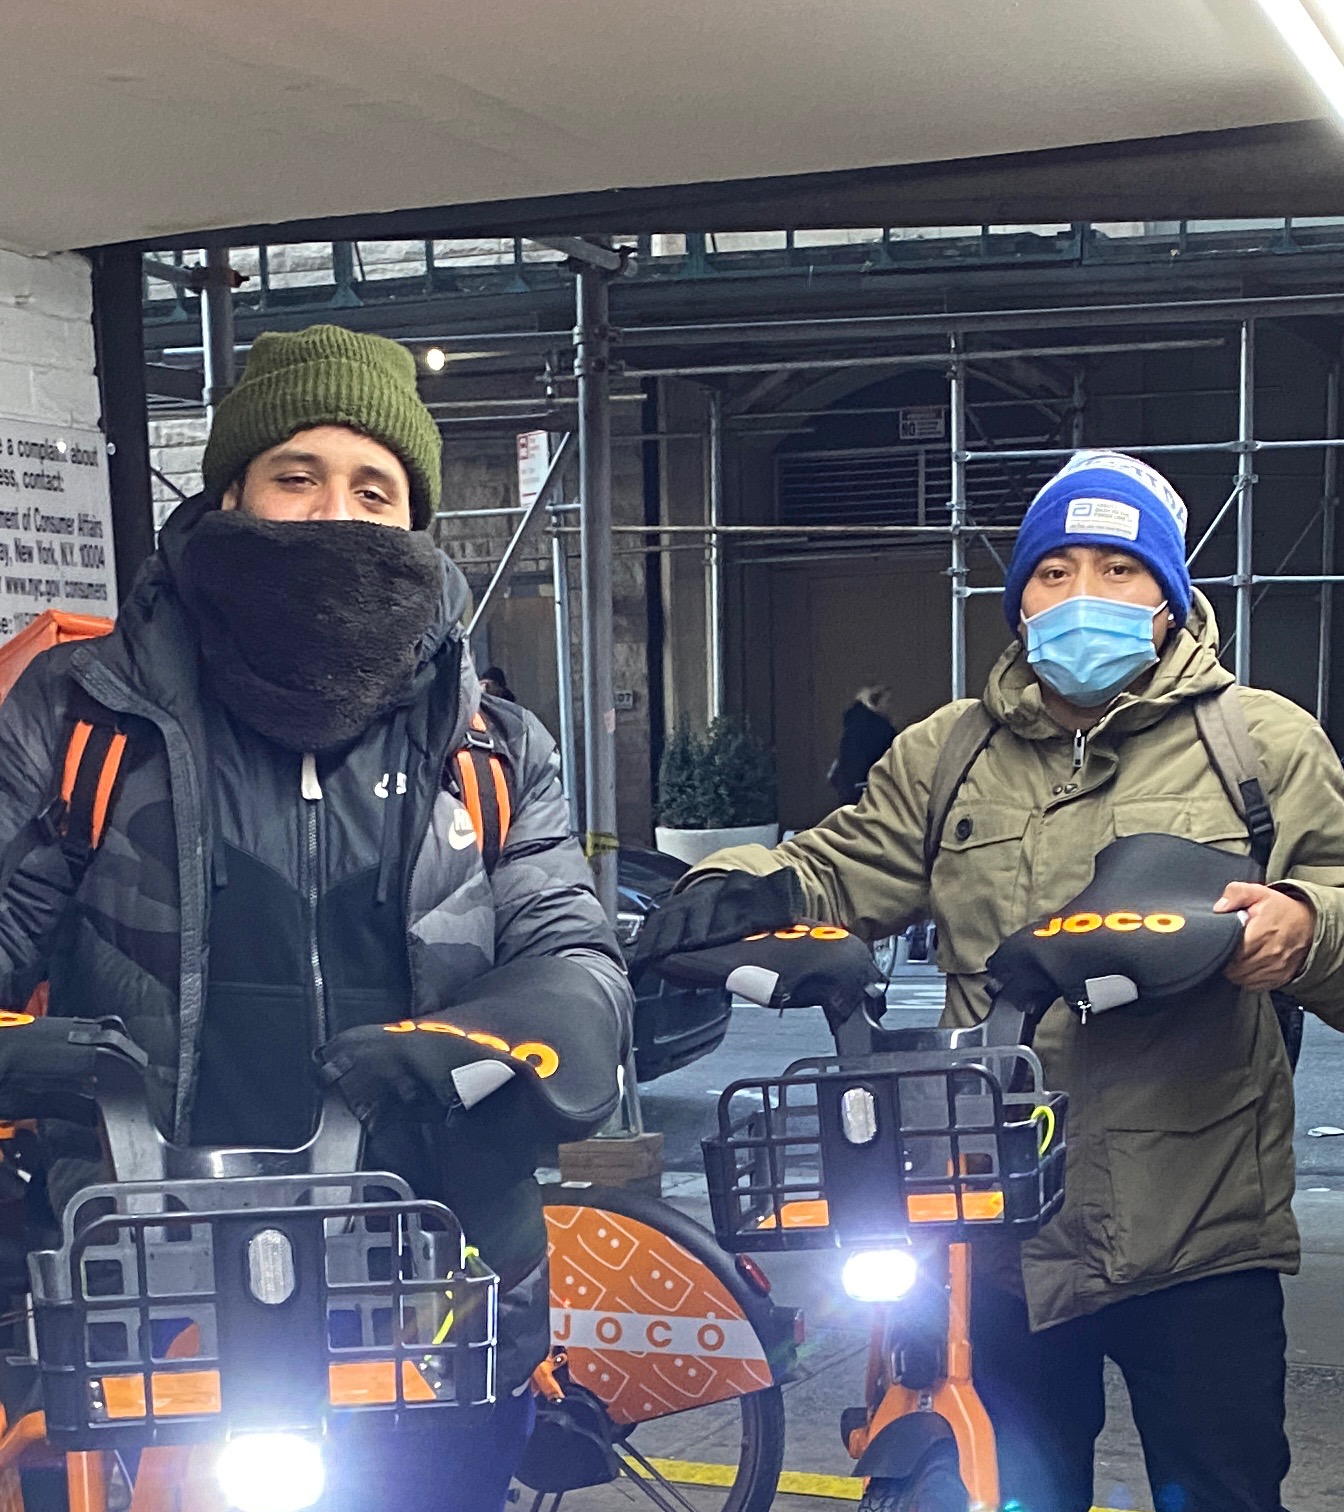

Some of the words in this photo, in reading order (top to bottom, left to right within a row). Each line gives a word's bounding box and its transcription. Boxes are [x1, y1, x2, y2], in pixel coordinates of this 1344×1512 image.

[7, 438, 14, 456] a
[71, 442, 99, 467] about
[22, 507, 31, 531] of
[34, 507, 74, 535] Consumer
[1033, 911, 1186, 938] JOCO
[553, 1313, 725, 1351] JOCO
